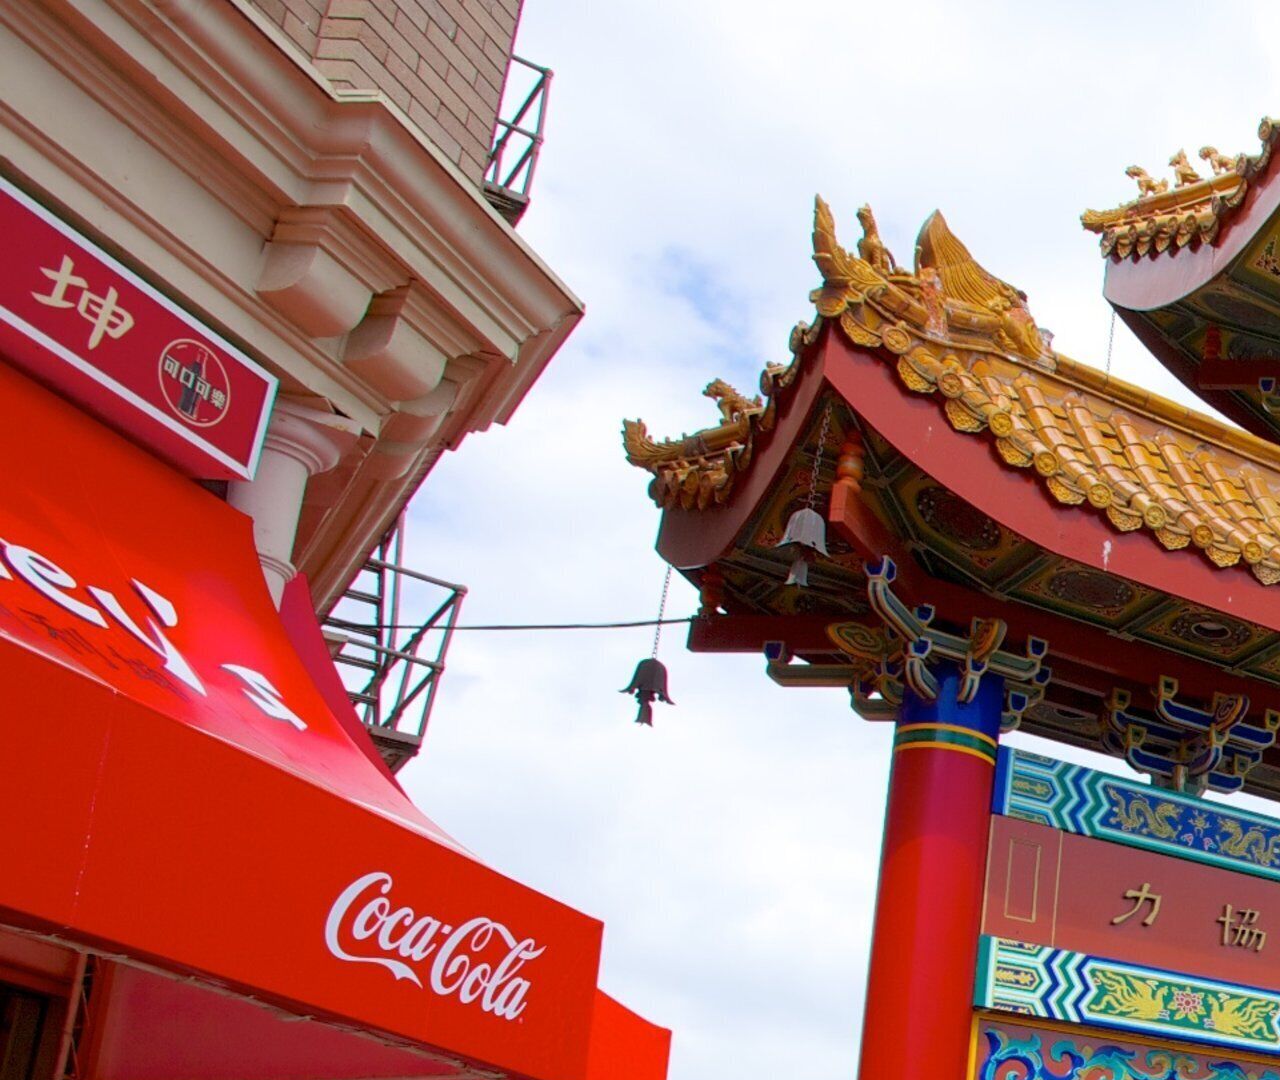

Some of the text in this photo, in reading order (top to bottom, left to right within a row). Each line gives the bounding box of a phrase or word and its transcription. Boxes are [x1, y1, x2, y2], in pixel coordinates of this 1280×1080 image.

[31, 254, 135, 350] 坤
[164, 354, 226, 410] 可口可樂
[325, 871, 547, 1020] Coca-Cola
